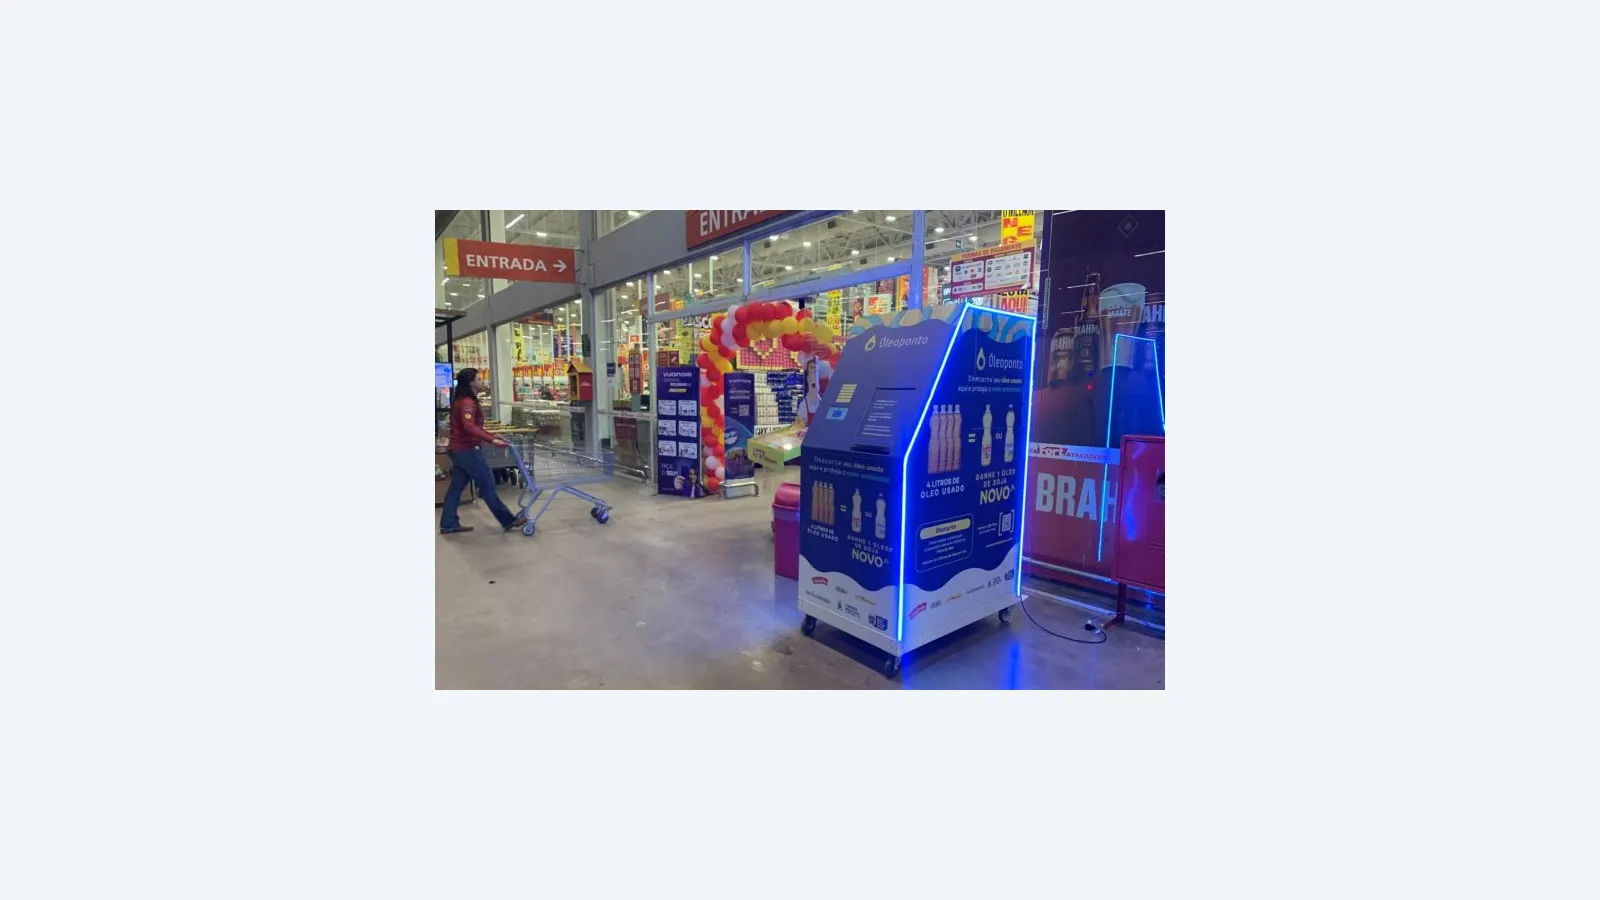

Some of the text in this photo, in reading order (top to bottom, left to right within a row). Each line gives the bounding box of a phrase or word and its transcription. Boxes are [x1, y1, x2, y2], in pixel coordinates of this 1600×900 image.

[466, 254, 547, 272] ENTRADA
[879, 335, 929, 348] Óleoponto
[988, 352, 1024, 370] Óleoponto
[931, 478, 952, 488] LITROS
[952, 476, 960, 484] DE
[976, 472, 995, 481] GANHE
[983, 478, 1007, 488] DE SOJA
[920, 484, 965, 499] ÓLEO USADO
[980, 486, 1010, 505] NOVO
[852, 548, 883, 568] NOVO
